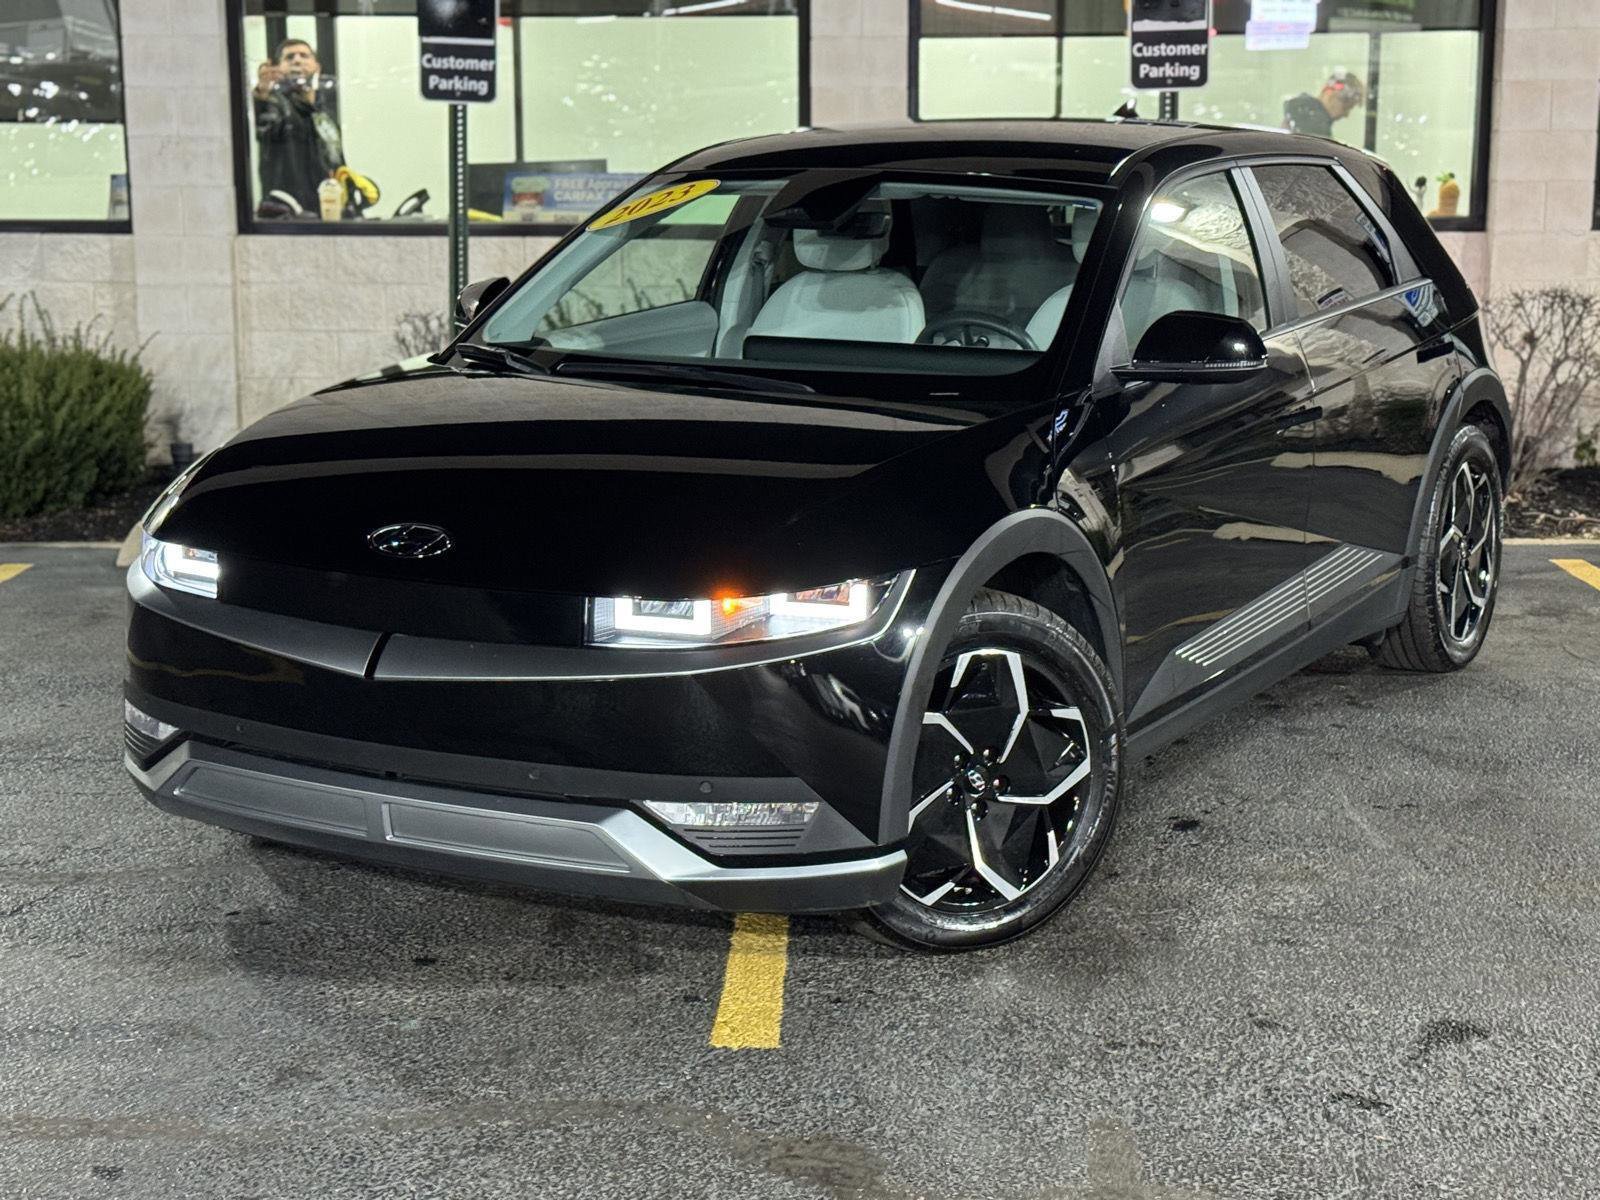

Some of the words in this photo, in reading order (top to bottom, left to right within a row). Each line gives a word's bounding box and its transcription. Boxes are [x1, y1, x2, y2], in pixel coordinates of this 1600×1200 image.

[1132, 42, 1208, 57] Customer
[421, 53, 495, 71] Customer
[1139, 62, 1200, 80] Parking
[429, 75, 489, 96] Parking
[603, 184, 697, 225] 2023
